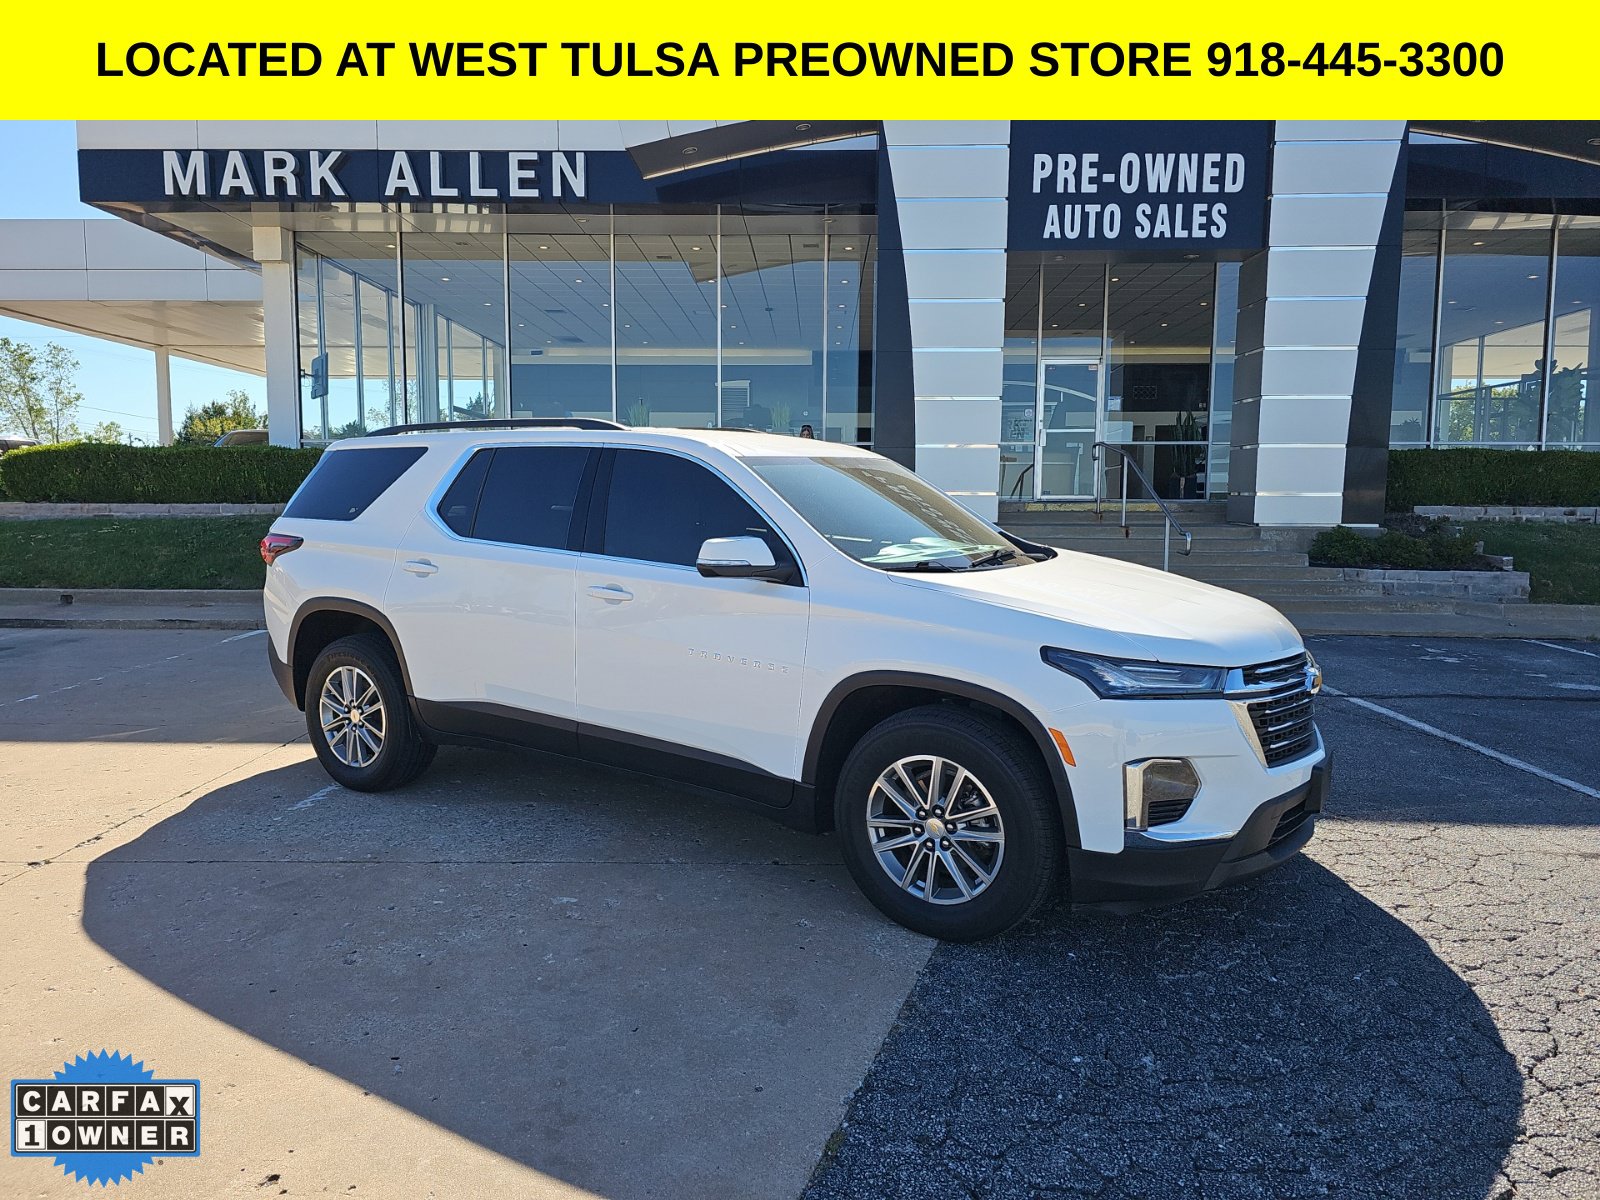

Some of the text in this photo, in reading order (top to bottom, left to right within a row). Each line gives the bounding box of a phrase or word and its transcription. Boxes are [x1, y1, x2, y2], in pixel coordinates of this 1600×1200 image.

[162, 150, 588, 198] MARK ALLEN
[1032, 152, 1246, 194] PRE-OWNED
[1043, 202, 1228, 240] AUTO SALES
[688, 647, 789, 674] TRAVERSE
